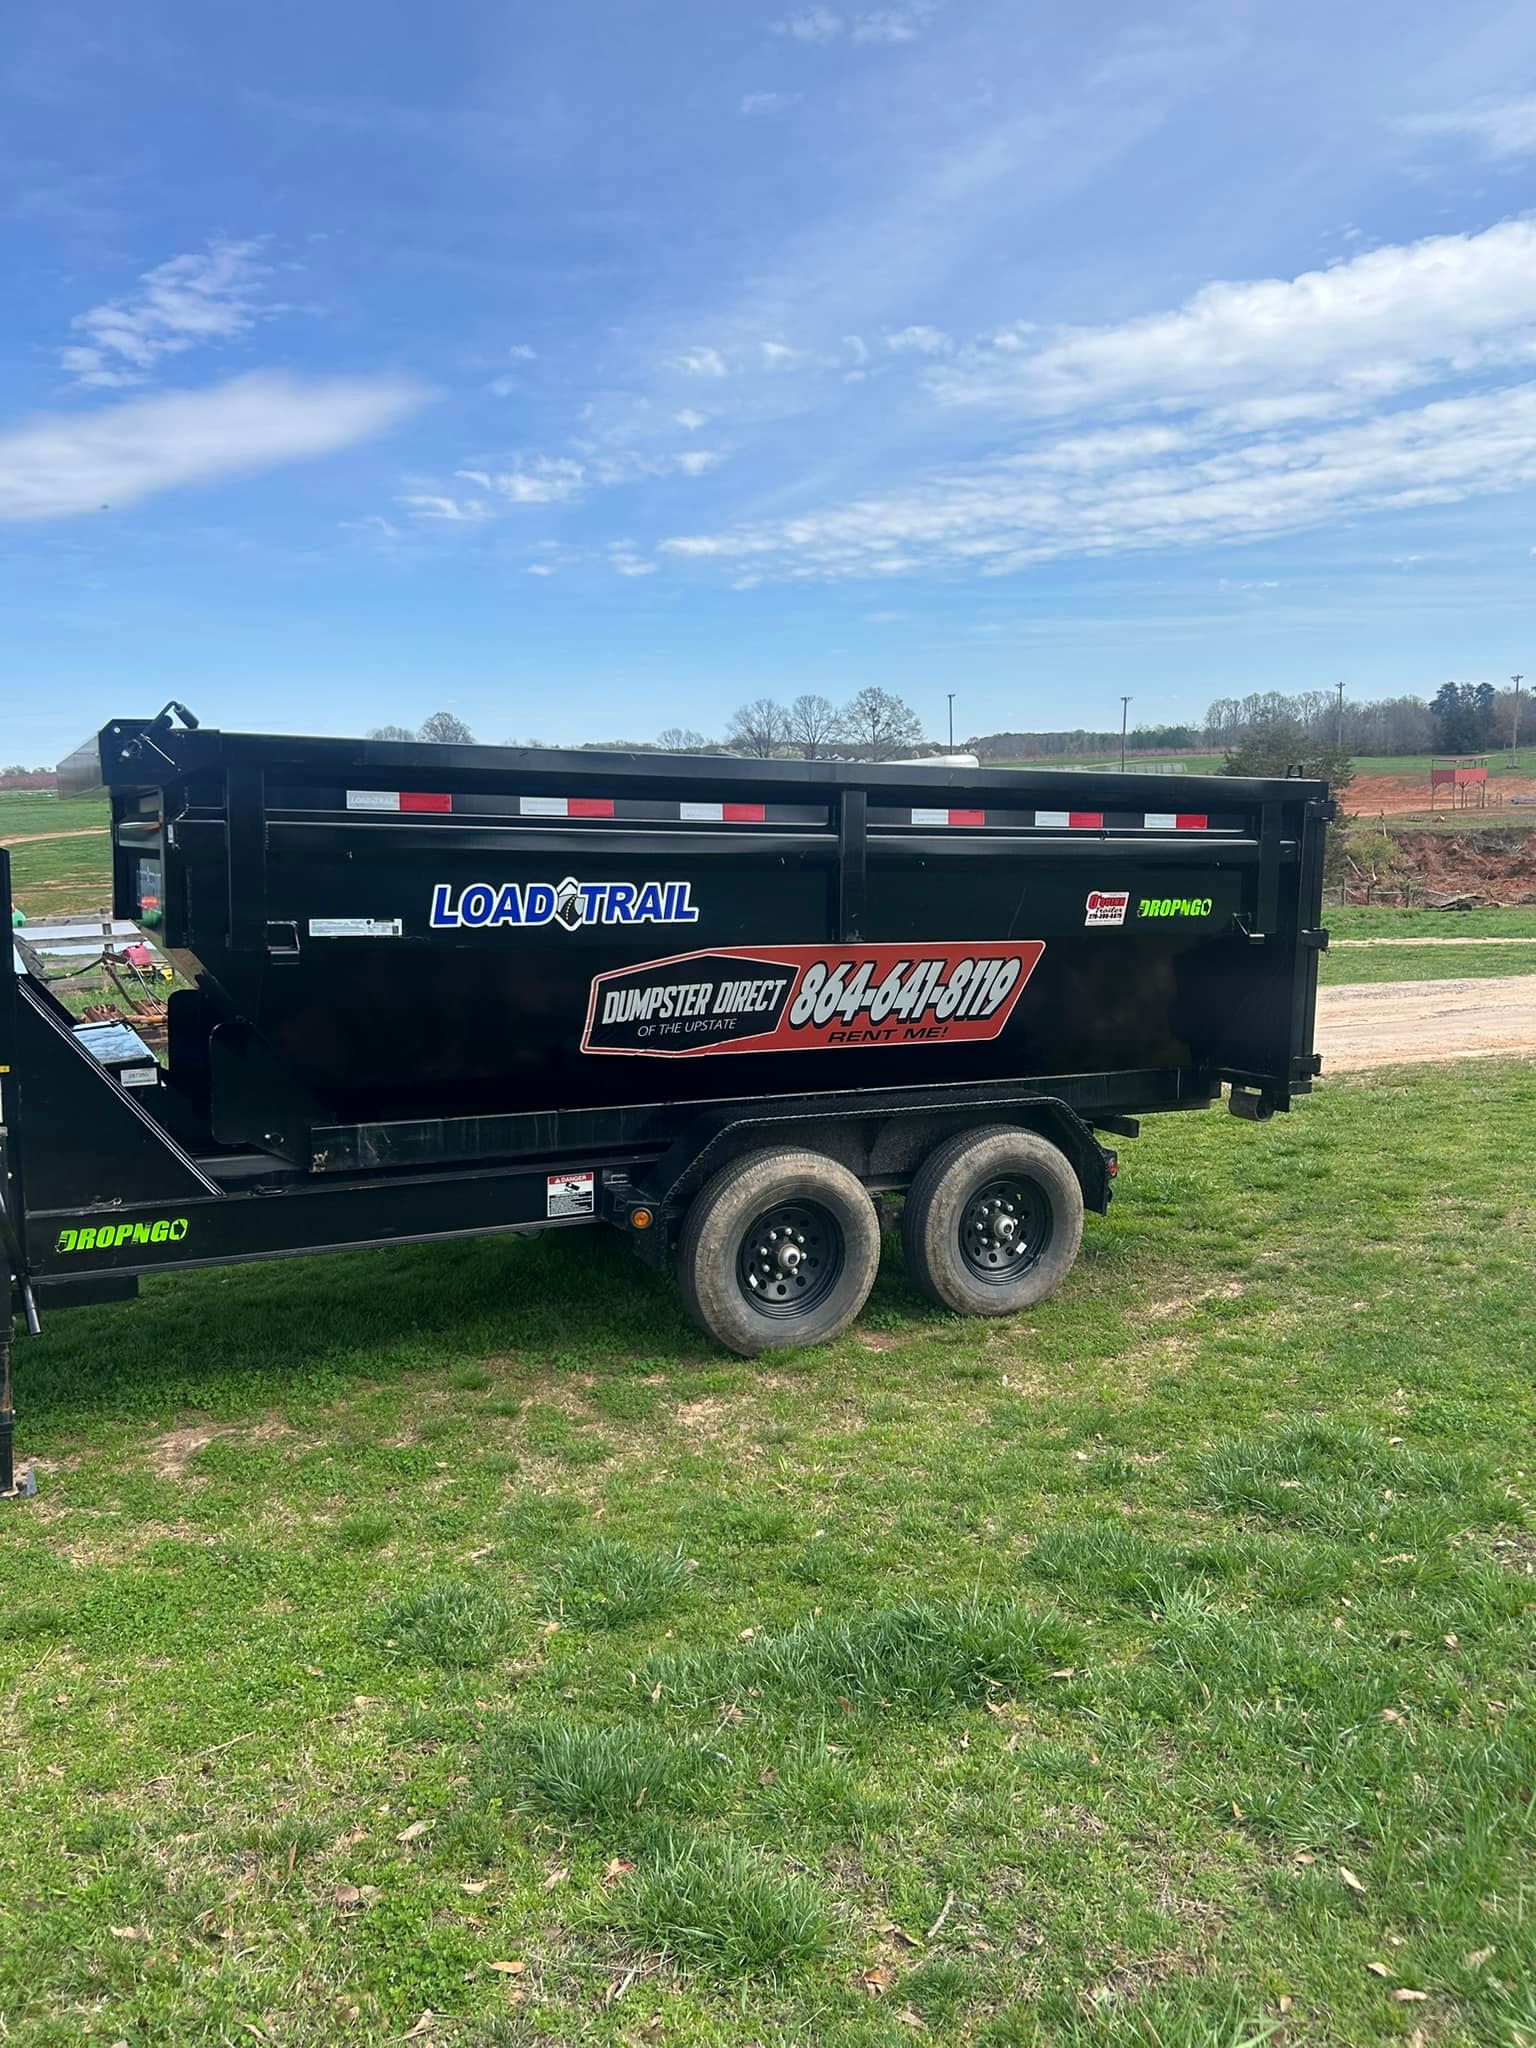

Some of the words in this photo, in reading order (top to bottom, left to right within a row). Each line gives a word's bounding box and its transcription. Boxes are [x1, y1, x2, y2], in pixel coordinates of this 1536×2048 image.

[430, 884, 558, 928] LOAD
[577, 882, 699, 924] TRAIL
[602, 984, 713, 1024] DUMPSTER
[712, 979, 788, 1014] DIRECT
[789, 958, 1021, 1026] 864-641-8119
[637, 1025, 656, 1037] OF
[659, 1022, 682, 1034] THE
[685, 1018, 737, 1032] UPSTATE
[828, 1027, 898, 1042] RENT
[903, 1027, 949, 1039] ME!
[561, 1175, 587, 1183] DANGER
